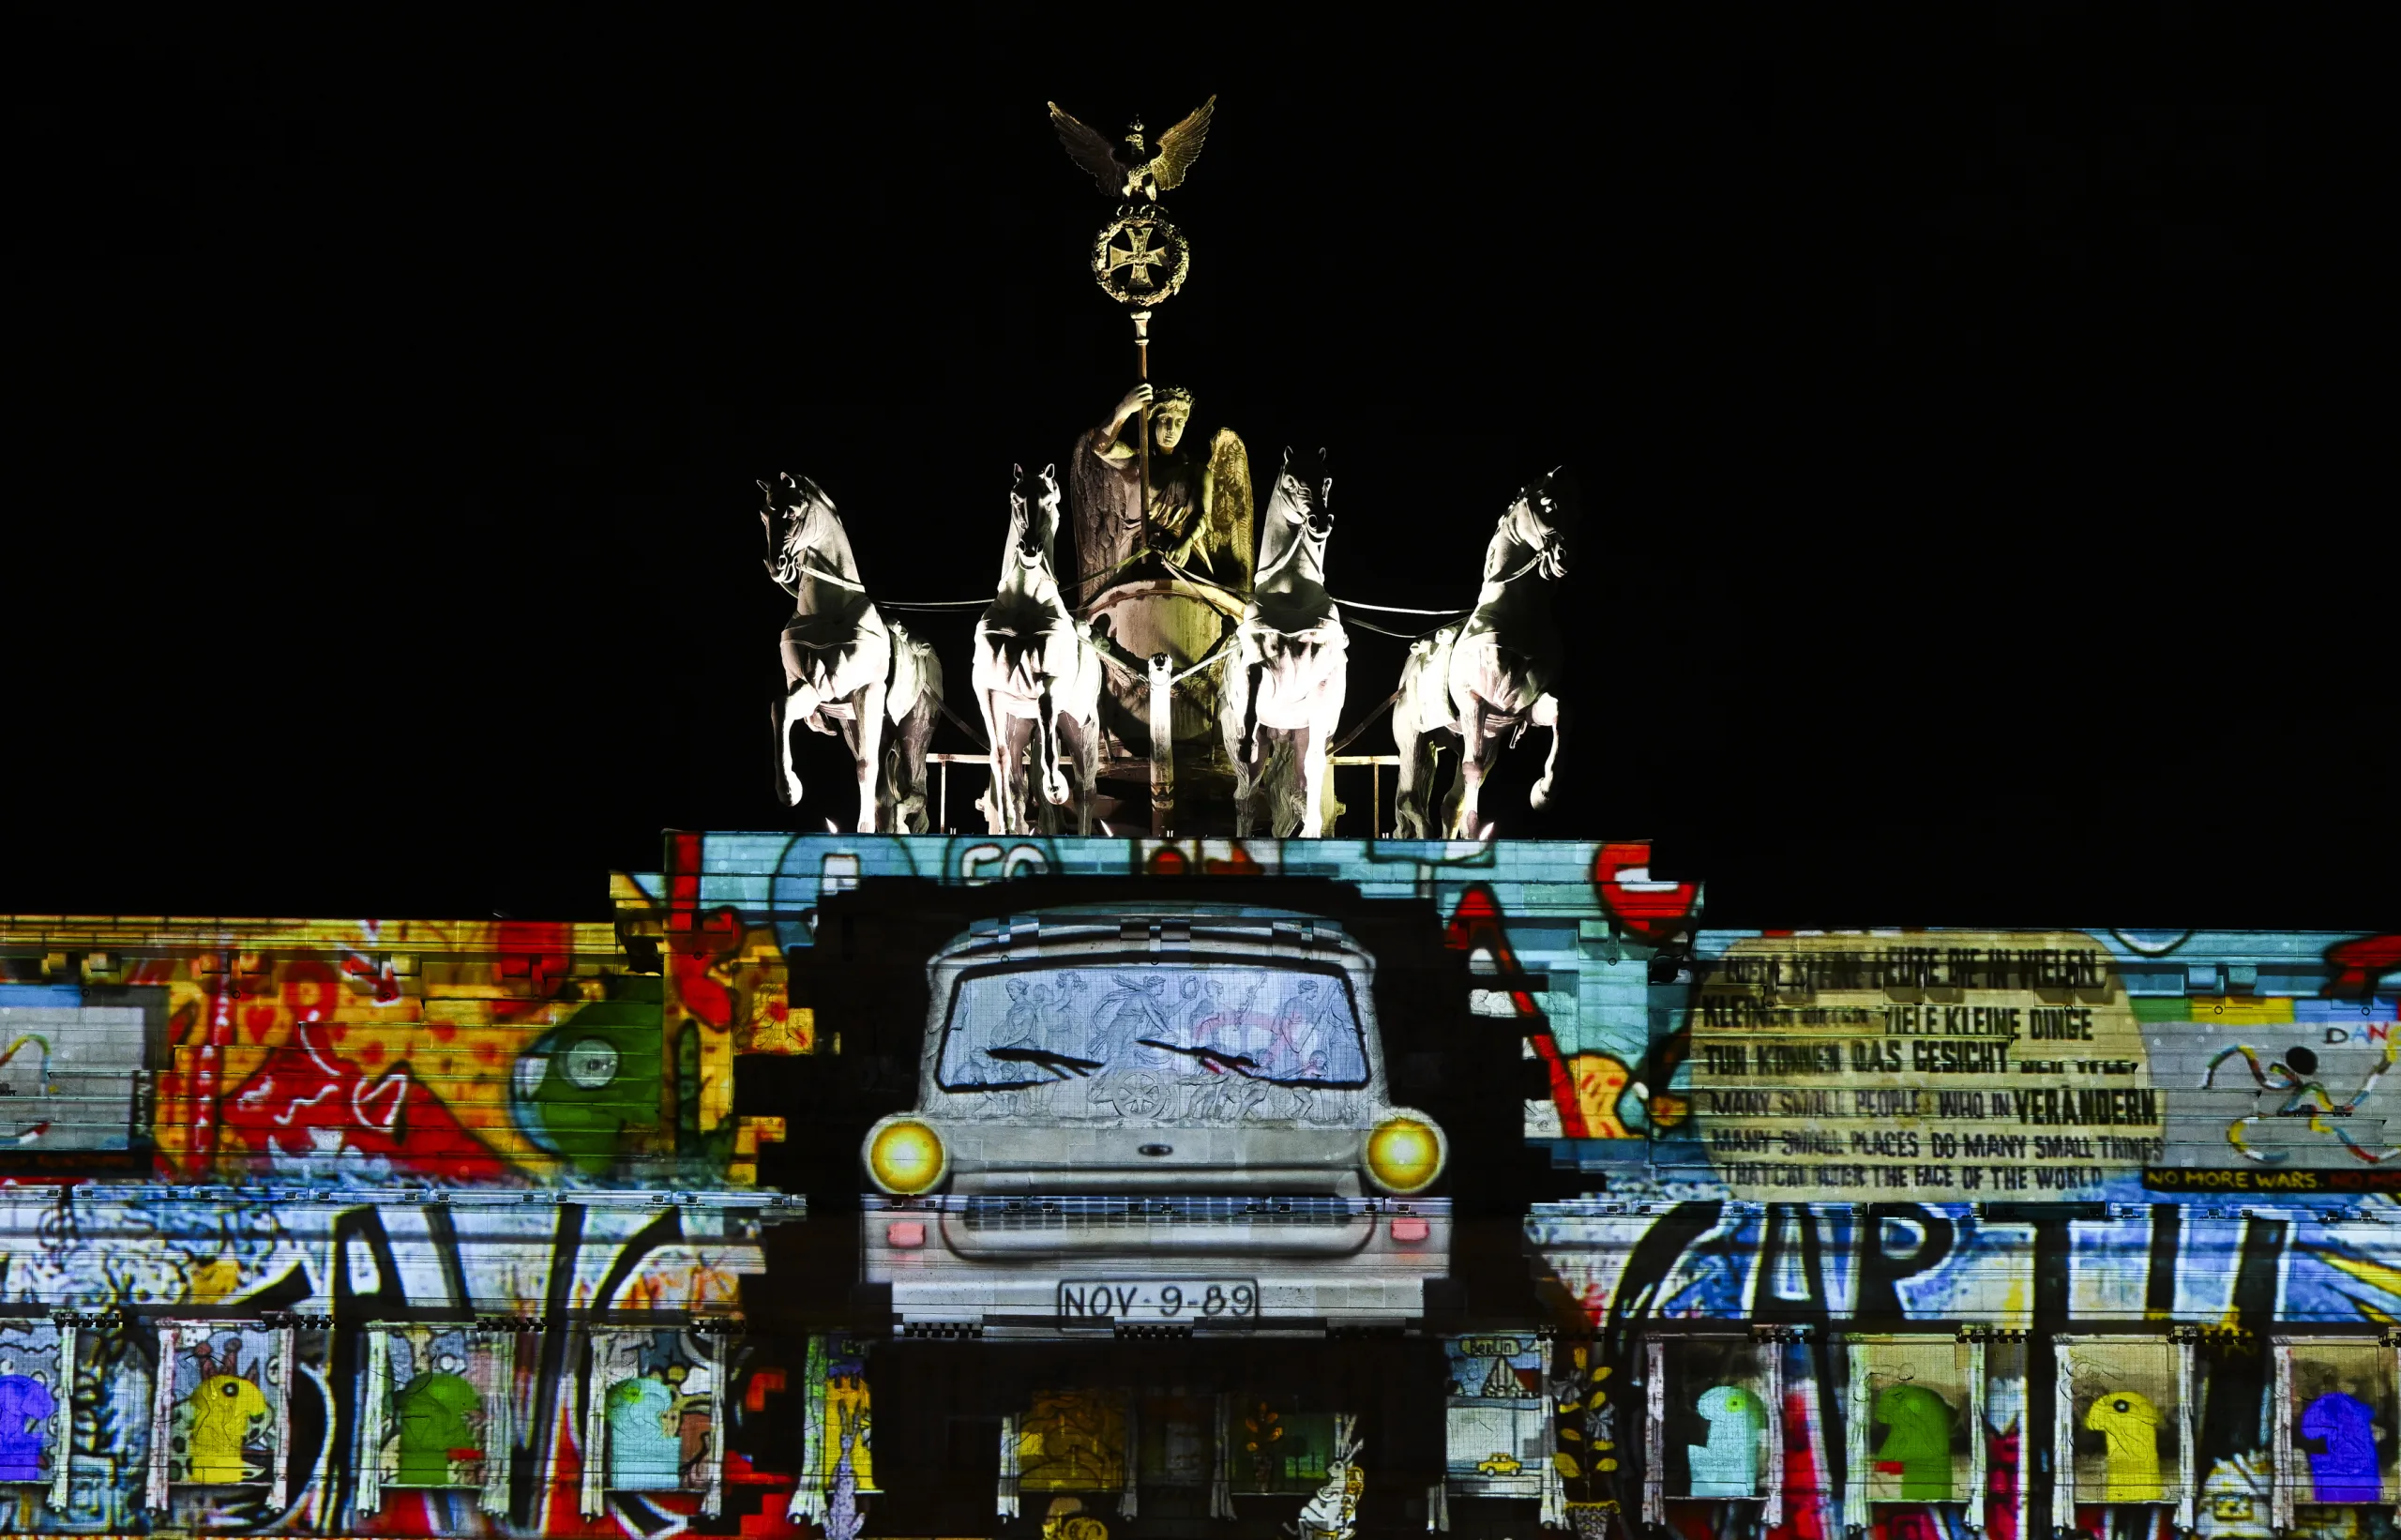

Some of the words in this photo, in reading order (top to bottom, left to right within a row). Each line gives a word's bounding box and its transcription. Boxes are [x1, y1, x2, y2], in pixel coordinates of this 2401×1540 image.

[1944, 1007, 2021, 1038] KLEINE
[2029, 1008, 2093, 1041] DINGE
[1852, 1040, 1902, 1073] DAS
[1912, 1040, 2009, 1074] GESICHT
[1940, 1091, 1983, 1119] WHO
[1992, 1092, 2011, 1116] IN
[1850, 1130, 1920, 1157] PLACES
[1931, 1132, 1956, 1158] DO
[1962, 1133, 2027, 1158] MANY
[2033, 1135, 2093, 1159] SMALL
[2097, 1135, 2164, 1162] THINGS
[1874, 1165, 1908, 1187] THE
[1914, 1165, 1954, 1187] FACE
[1962, 1166, 1983, 1190] OF
[1989, 1166, 2027, 1190] THE
[2034, 1166, 2104, 1191] WORLD
[2146, 1170, 2178, 1186] NO
[2184, 1170, 2248, 1187] MORE
